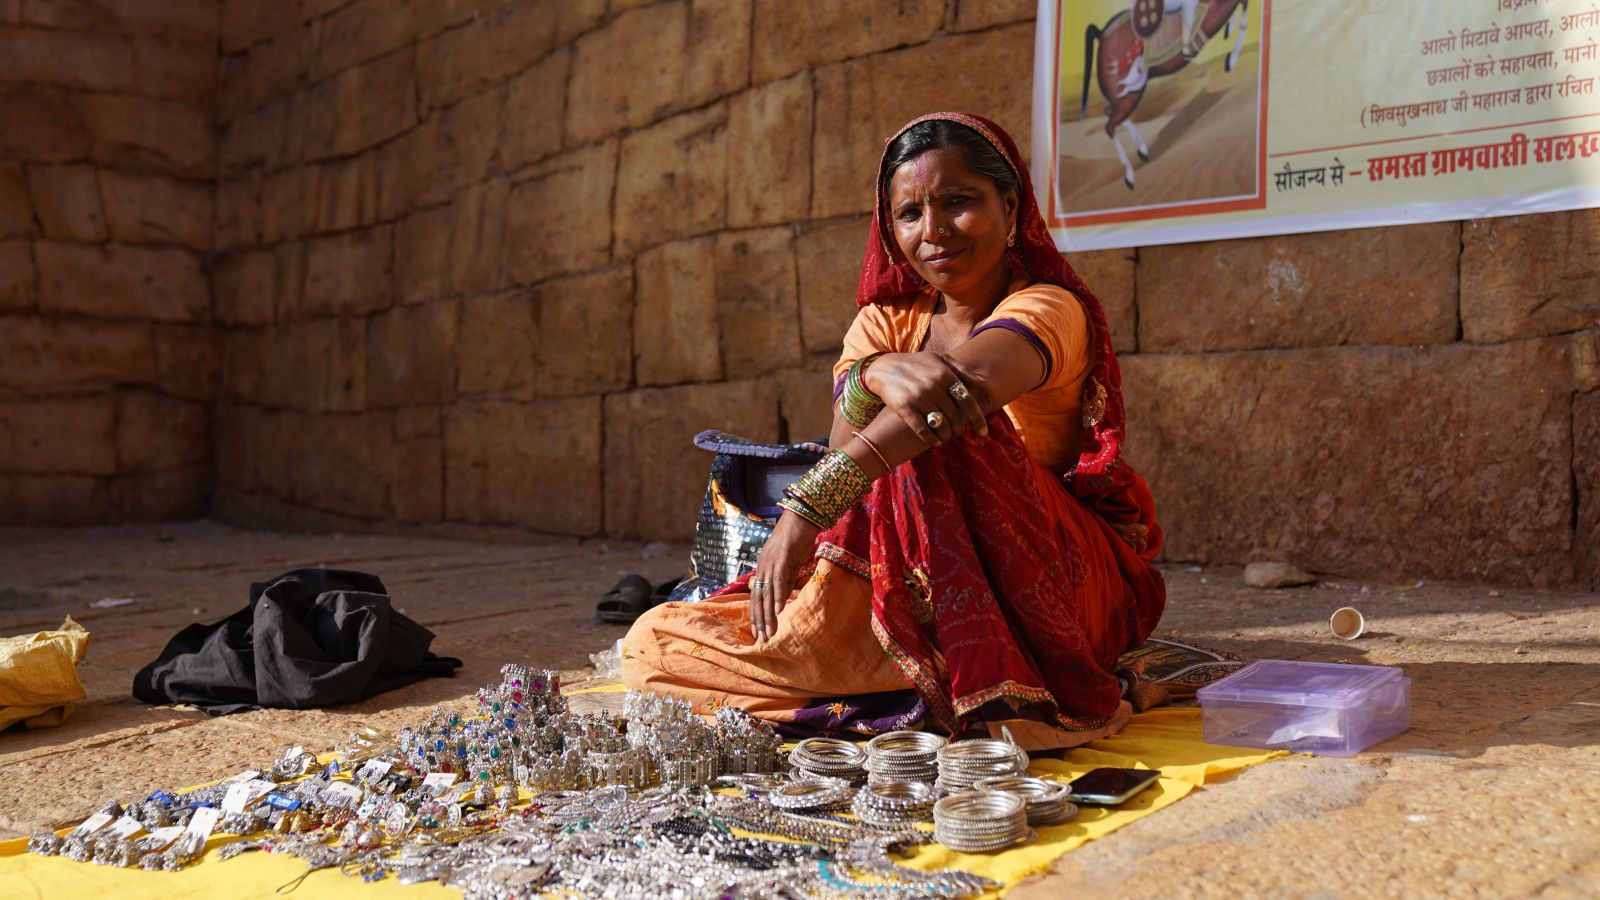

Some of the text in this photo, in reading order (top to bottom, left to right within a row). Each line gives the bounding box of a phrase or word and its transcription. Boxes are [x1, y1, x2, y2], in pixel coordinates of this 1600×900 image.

[1421, 30, 1457, 55] आलो
[1461, 22, 1500, 49] मिटावे
[1504, 19, 1553, 42] आपदा,
[1474, 54, 1495, 78] करे
[1499, 51, 1558, 76] सहायता,
[1564, 37, 1598, 63] मानो
[1451, 90, 1469, 112] जी
[1472, 88, 1521, 112] महाराज
[1525, 83, 1554, 105] द्वारा
[1557, 75, 1594, 97] रचित
[1274, 162, 1326, 192] सौजन्य
[1330, 157, 1345, 187] से
[1367, 152, 1428, 181] समस्त
[1431, 132, 1530, 176] ग्रामवासी
